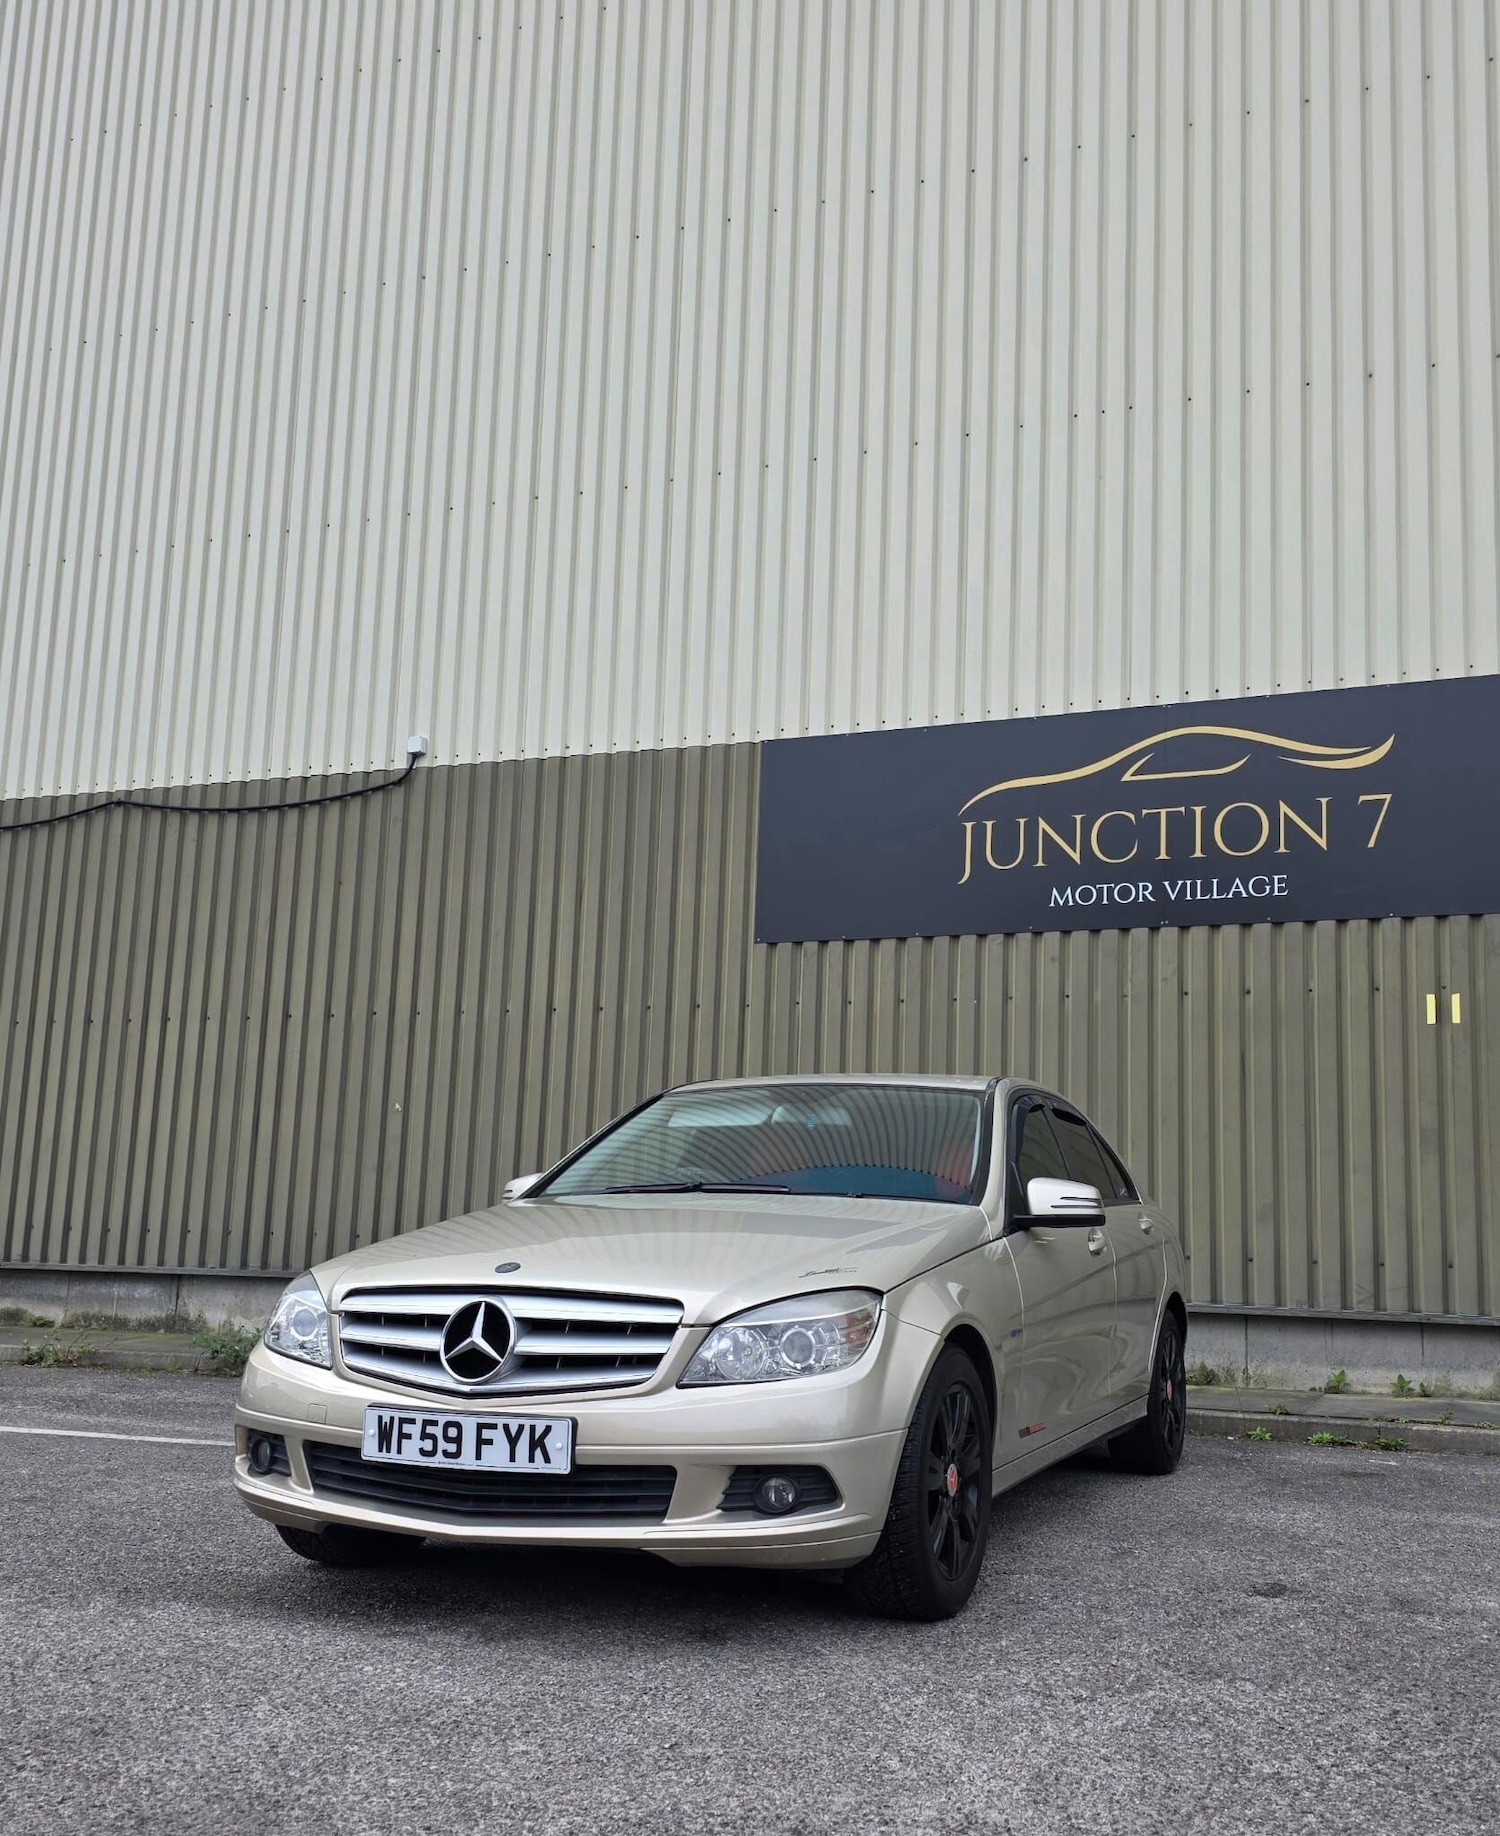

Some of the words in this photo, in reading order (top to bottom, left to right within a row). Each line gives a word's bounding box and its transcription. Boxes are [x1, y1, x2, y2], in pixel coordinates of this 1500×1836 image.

[957, 796, 1333, 885] JUNCTION
[1357, 793, 1393, 849] 7
[1048, 882, 1157, 908] MOTOR
[1162, 874, 1290, 901] VILLAGE
[377, 1414, 463, 1460] WF59
[475, 1422, 553, 1464] FYK
